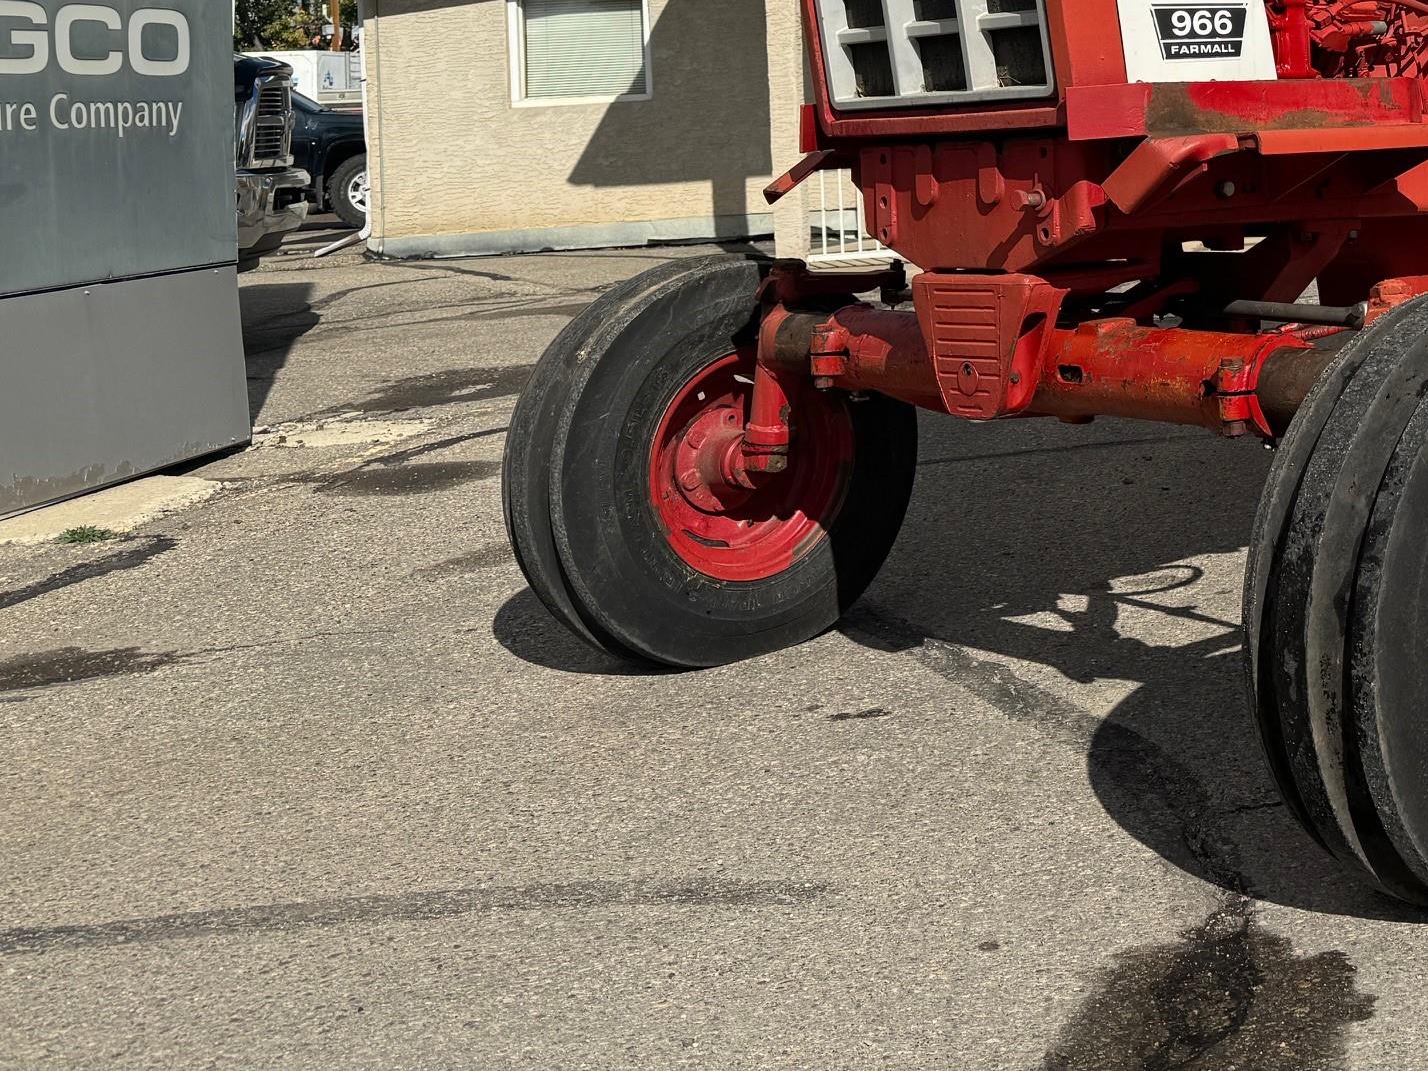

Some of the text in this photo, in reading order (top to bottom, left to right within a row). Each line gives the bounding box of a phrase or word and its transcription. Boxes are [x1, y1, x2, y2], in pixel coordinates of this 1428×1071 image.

[1171, 9, 1233, 36] 966
[1170, 43, 1236, 55] FARMALL
[0, 93, 183, 138] re Company
